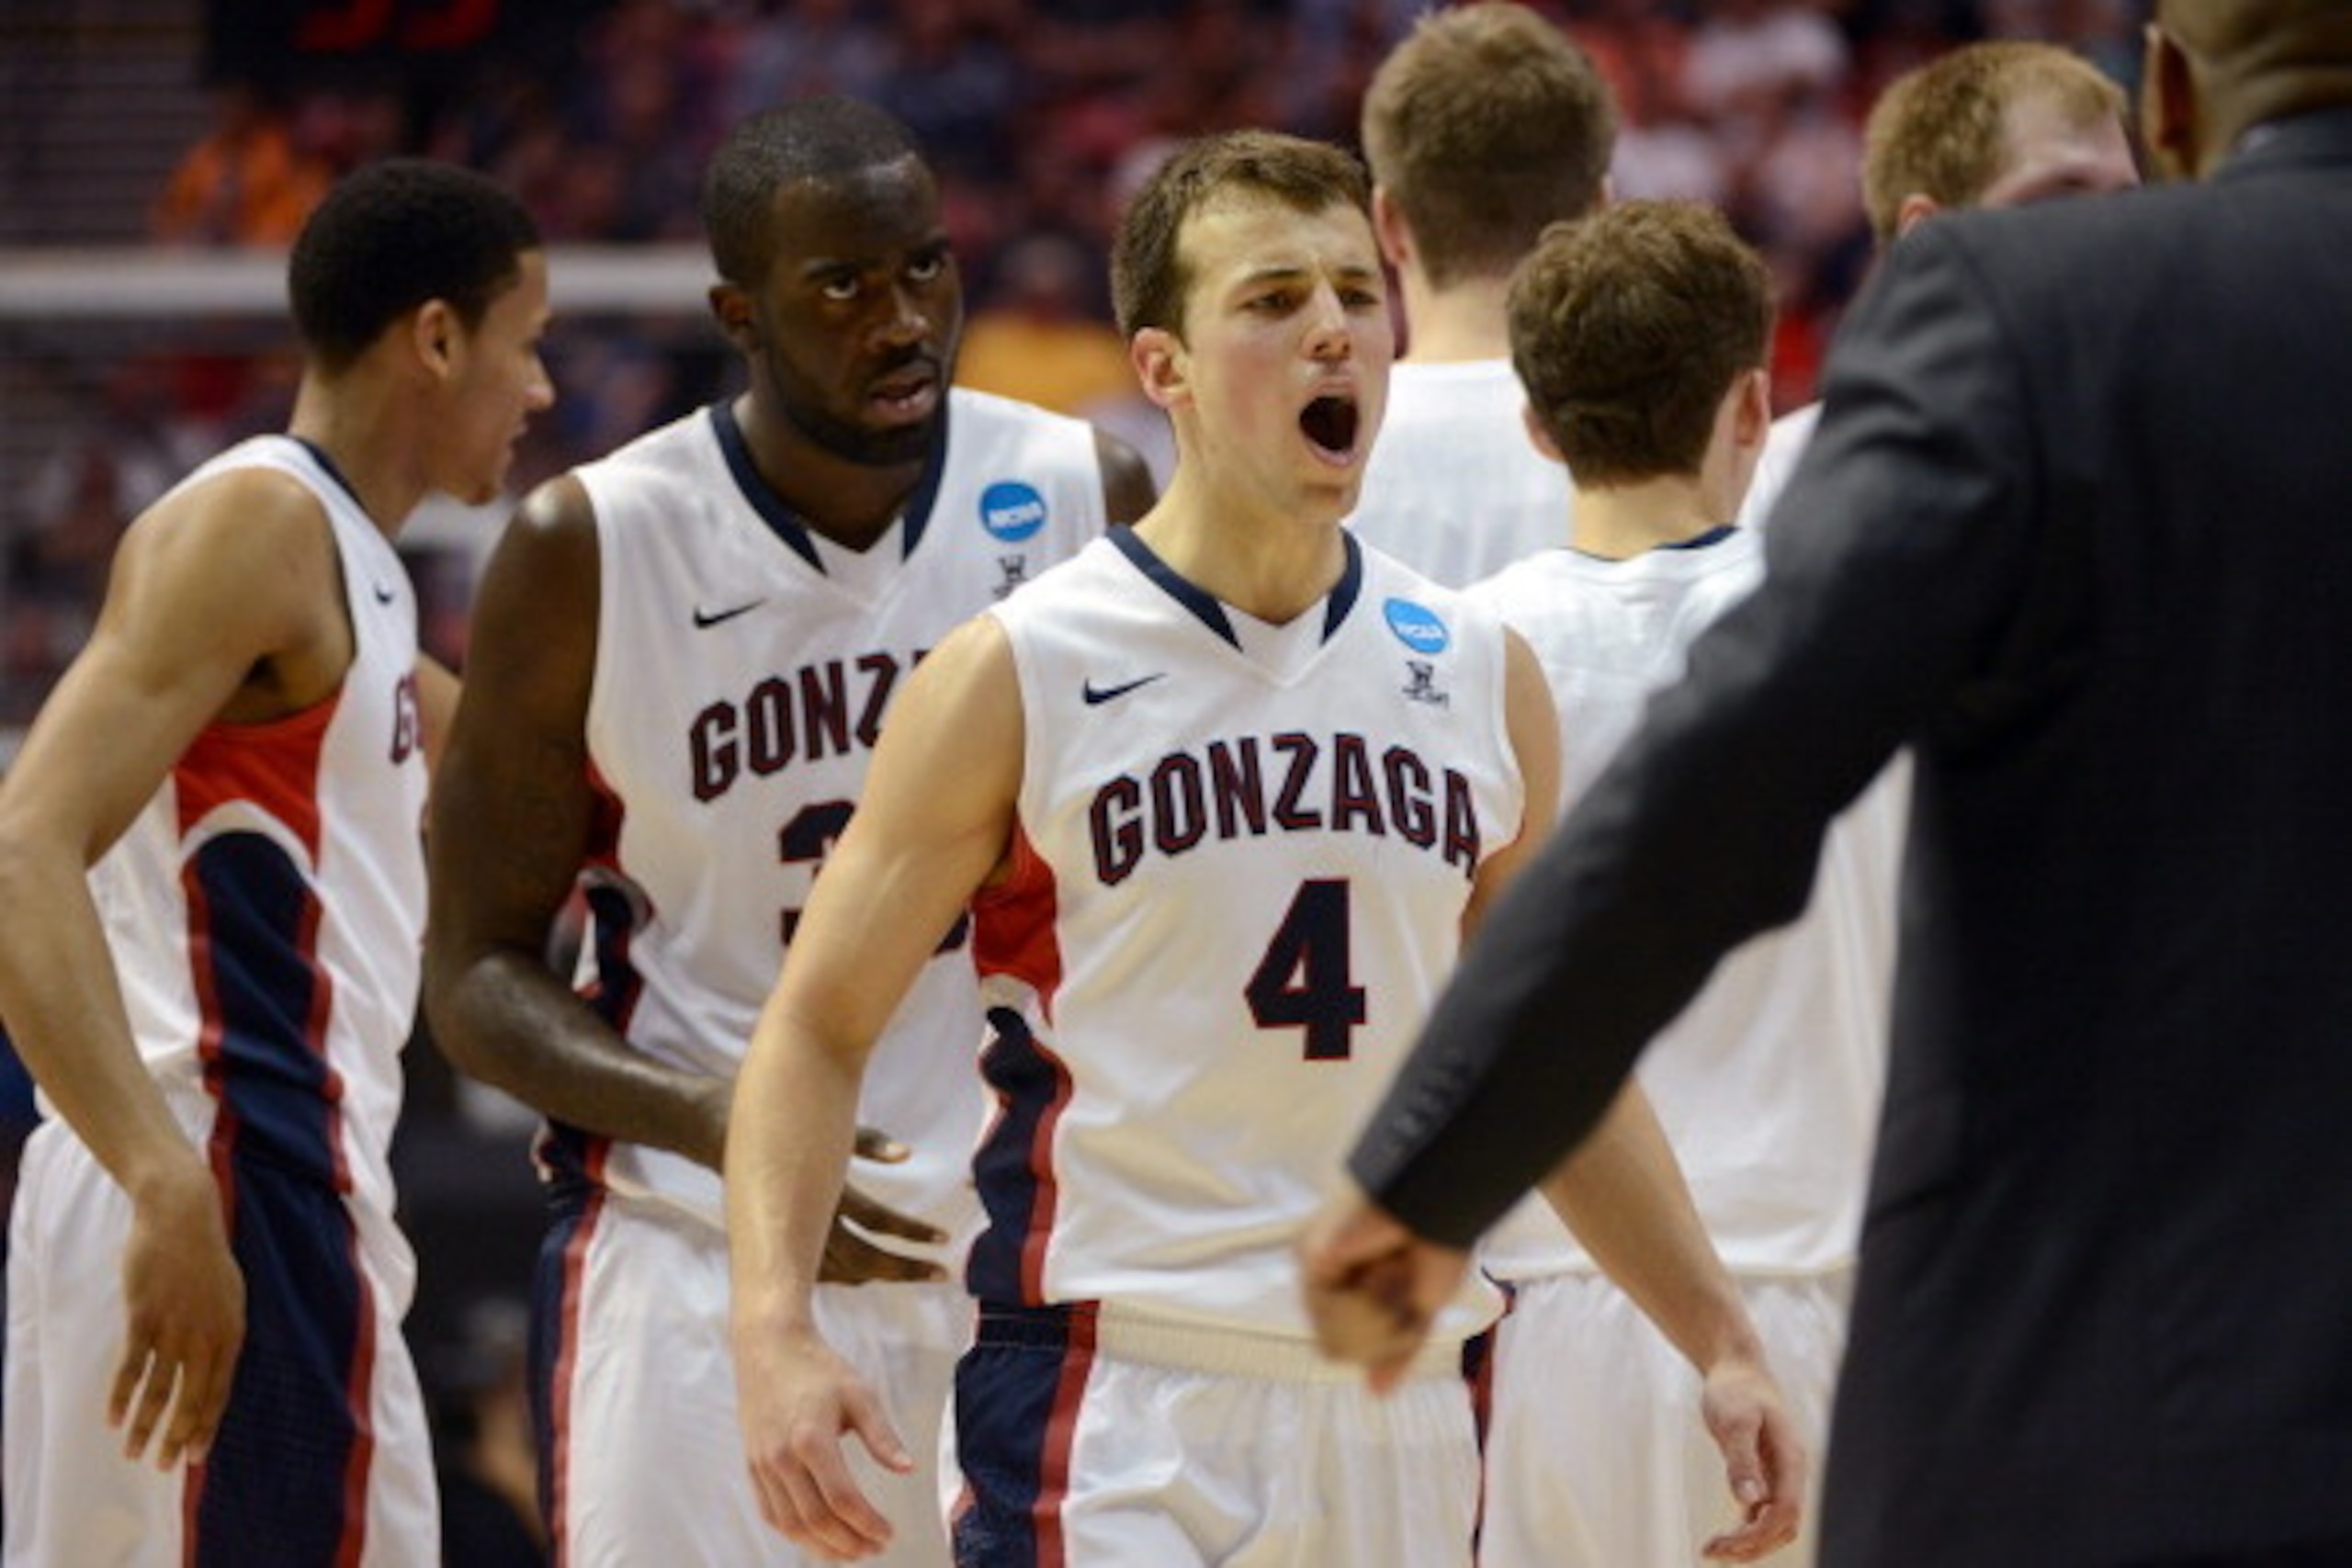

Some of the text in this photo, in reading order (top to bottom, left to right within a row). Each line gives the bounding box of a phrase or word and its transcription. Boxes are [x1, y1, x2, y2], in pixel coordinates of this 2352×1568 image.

[689, 649, 930, 805] GONZ
[1090, 732, 1480, 882] GONZAGA
[1244, 877, 1365, 1061] 4
